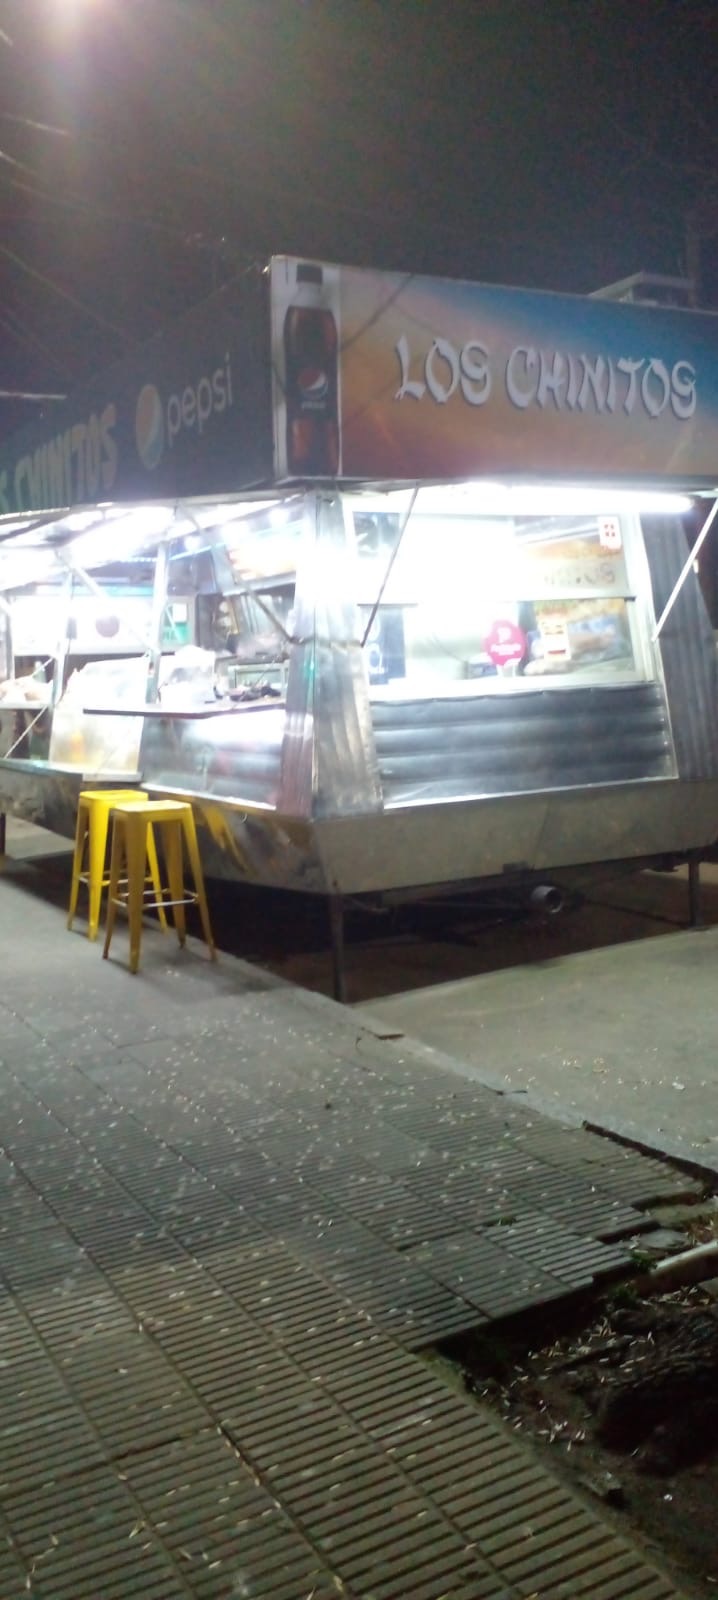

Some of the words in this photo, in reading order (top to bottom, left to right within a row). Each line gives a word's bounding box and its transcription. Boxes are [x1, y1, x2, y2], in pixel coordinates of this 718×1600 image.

[166, 351, 233, 449] pepsi
[394, 334, 492, 406] LOS
[505, 345, 698, 421] CHINITOS
